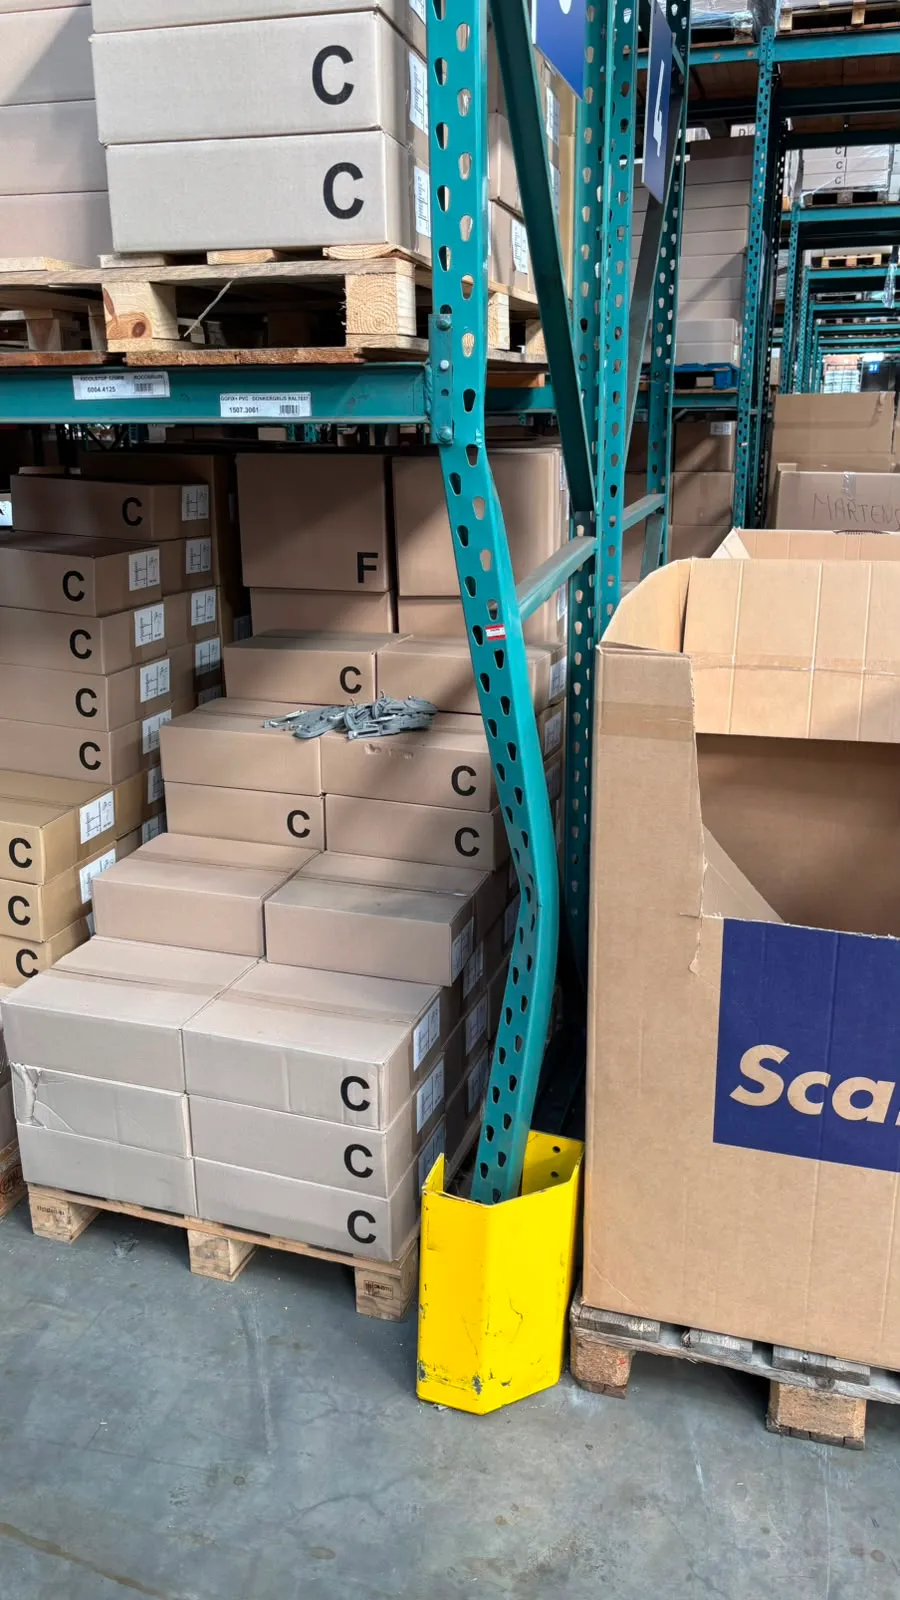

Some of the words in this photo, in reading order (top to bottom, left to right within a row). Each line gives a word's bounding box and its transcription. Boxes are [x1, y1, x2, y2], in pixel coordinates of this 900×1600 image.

[312, 45, 355, 105] C
[835, 160, 843, 170] C
[323, 162, 365, 219] C
[122, 497, 143, 526] C
[357, 552, 378, 583] F
[63, 571, 85, 601] C
[70, 630, 92, 659] C
[340, 667, 362, 695] C
[76, 688, 98, 717] C
[79, 742, 101, 770] C
[452, 766, 477, 796] C
[287, 810, 311, 838] C
[9, 838, 33, 868] C
[455, 827, 480, 856] C
[8, 896, 31, 925] C
[16, 949, 38, 978] C
[341, 1076, 370, 1111] C
[729, 1044, 900, 1126] Sca
[344, 1144, 373, 1178] C
[348, 1210, 377, 1244] C
